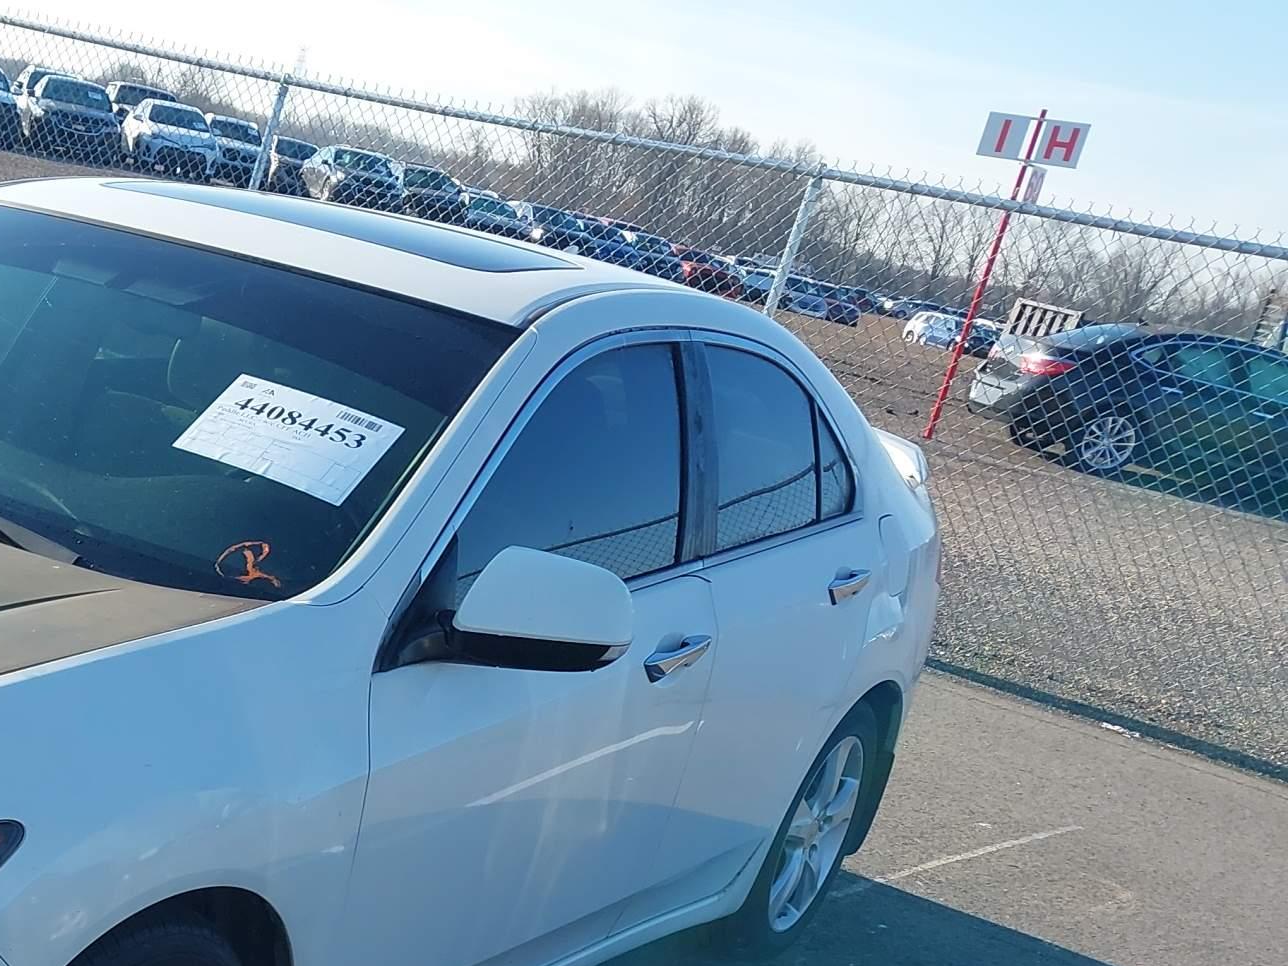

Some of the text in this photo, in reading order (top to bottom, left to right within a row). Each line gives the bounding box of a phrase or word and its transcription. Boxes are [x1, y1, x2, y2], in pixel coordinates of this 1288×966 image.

[994, 119, 1012, 153] I
[1043, 125, 1081, 162] H
[234, 397, 367, 449] 44084453
